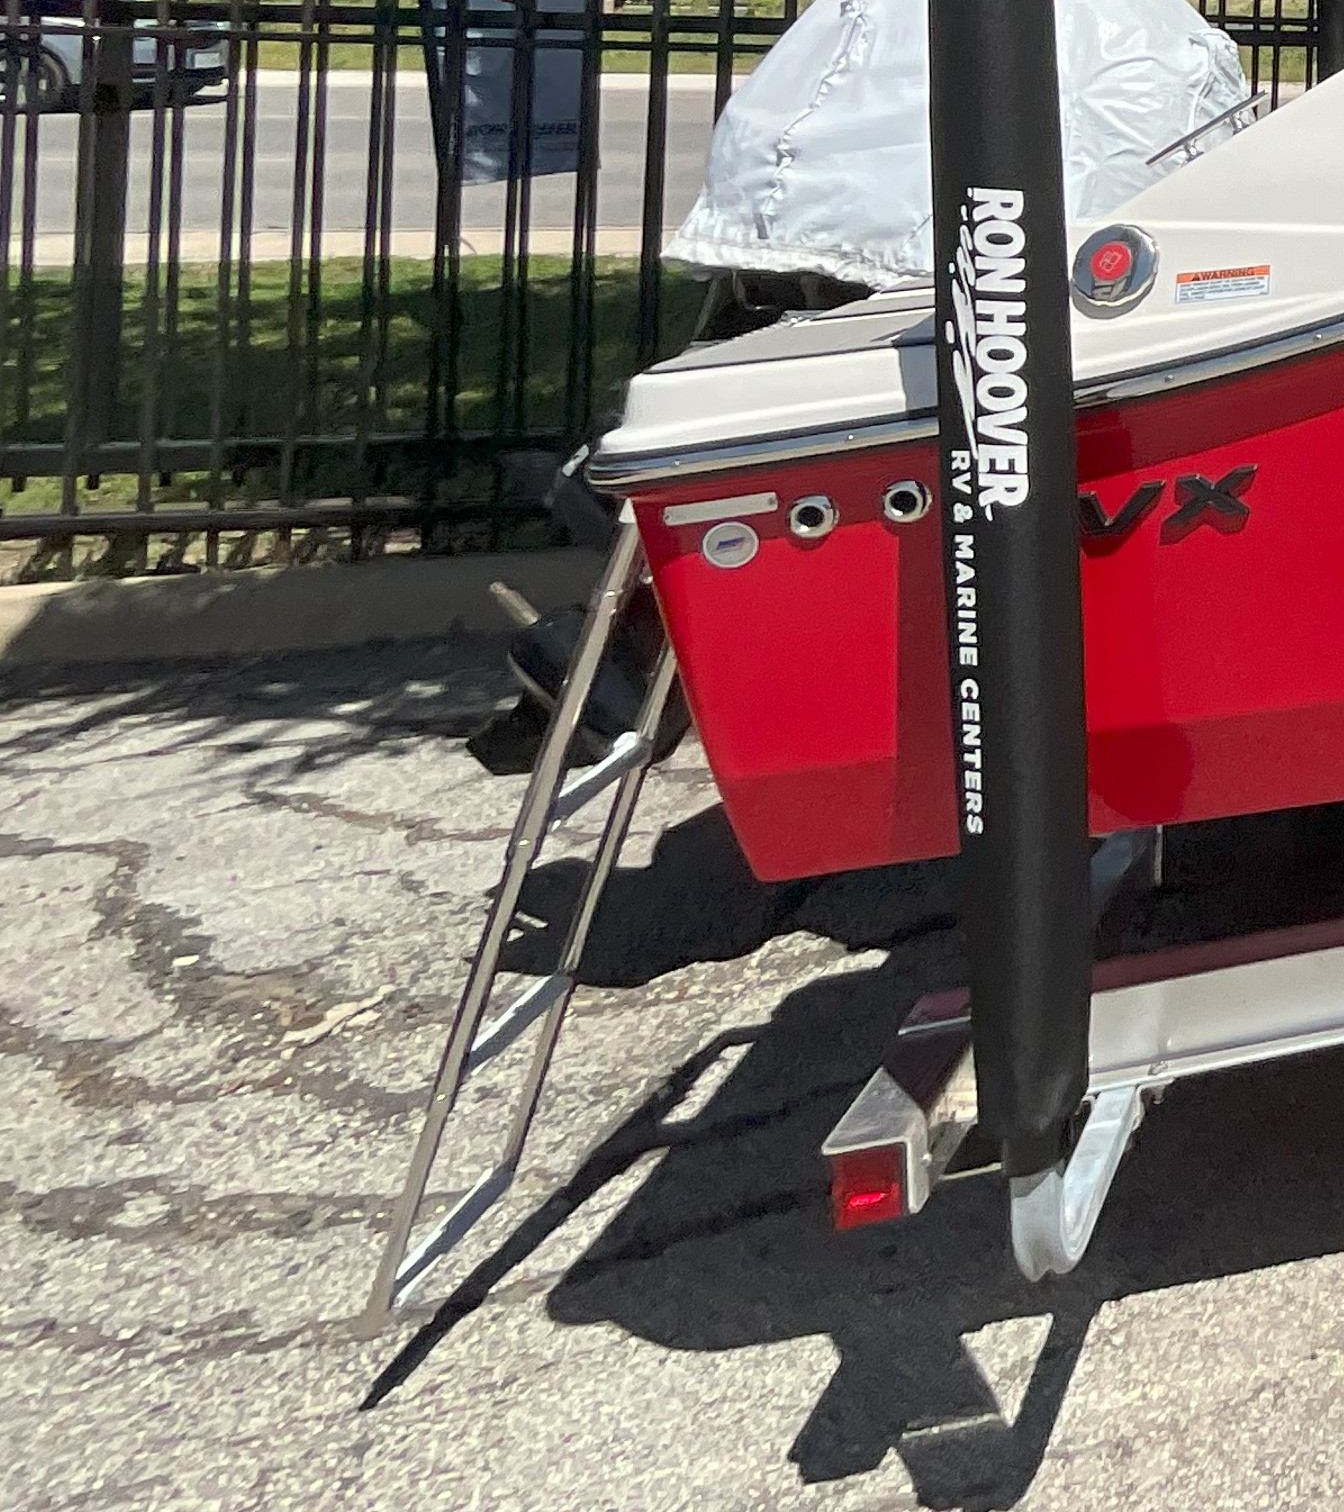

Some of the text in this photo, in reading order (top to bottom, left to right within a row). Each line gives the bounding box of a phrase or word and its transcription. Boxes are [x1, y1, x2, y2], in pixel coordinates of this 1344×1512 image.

[971, 186, 1031, 510] RON HOOVER
[1202, 267, 1255, 281] WARNING
[950, 450, 985, 836] RV & MARINE CENTERS
